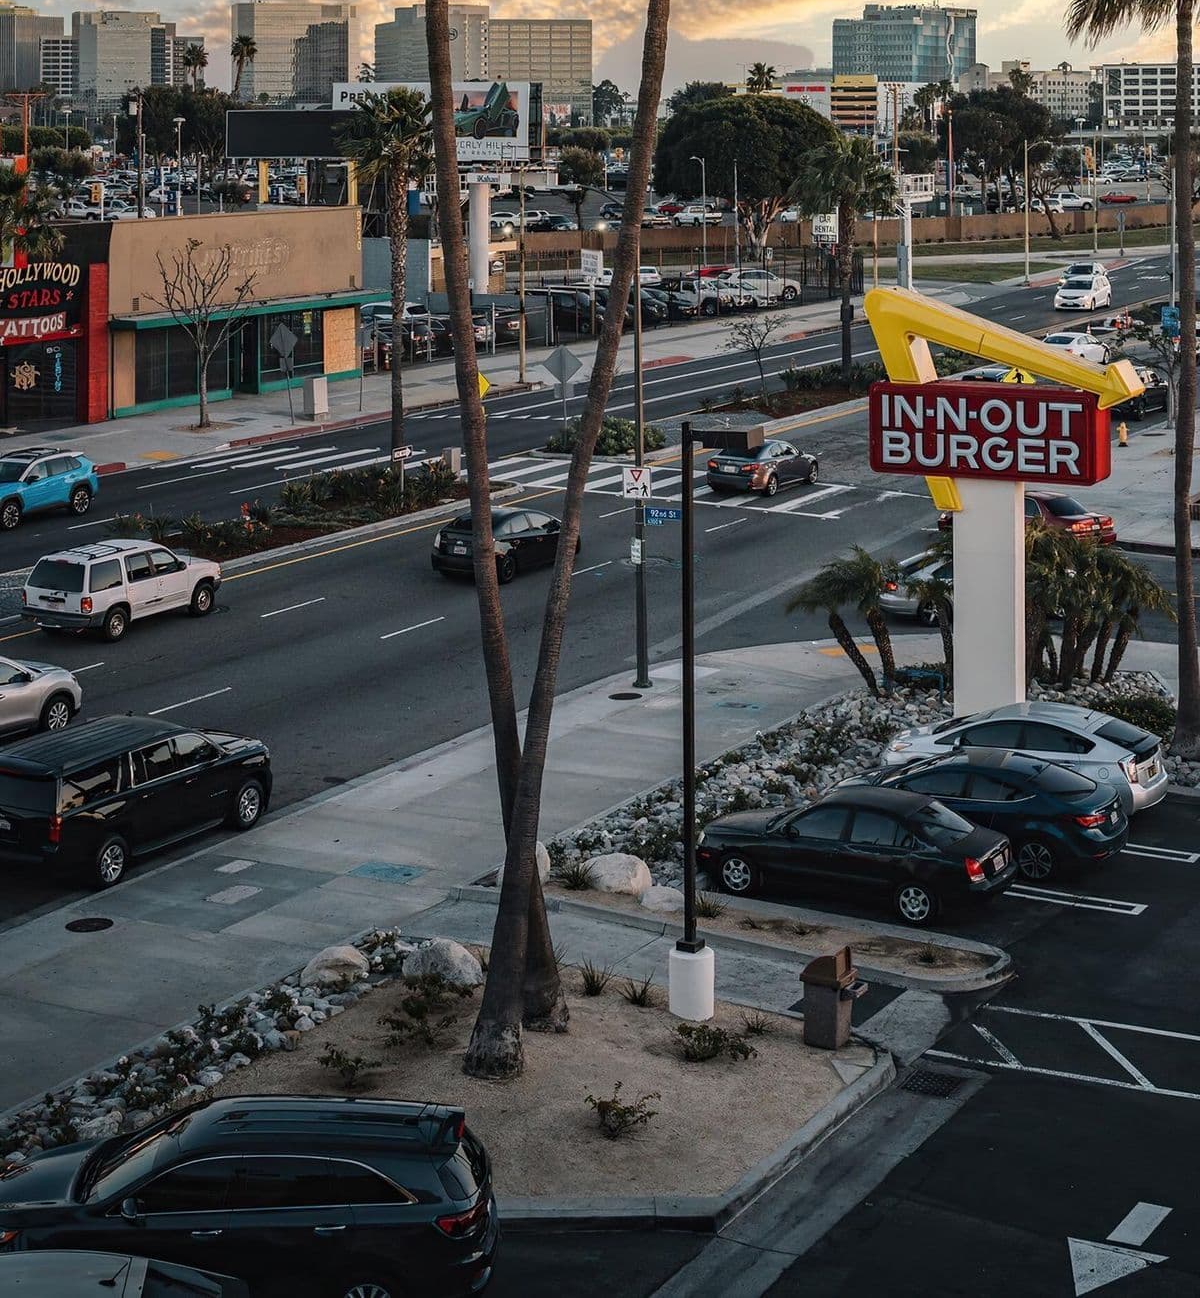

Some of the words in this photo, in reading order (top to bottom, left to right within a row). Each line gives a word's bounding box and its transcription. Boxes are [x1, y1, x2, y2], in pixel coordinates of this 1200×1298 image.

[7, 288, 61, 309] STARS
[881, 394, 1083, 437] IN-N-OUT
[882, 430, 1081, 475] BURGER
[650, 509, 667, 518] 92nd
[668, 510, 677, 519] St
